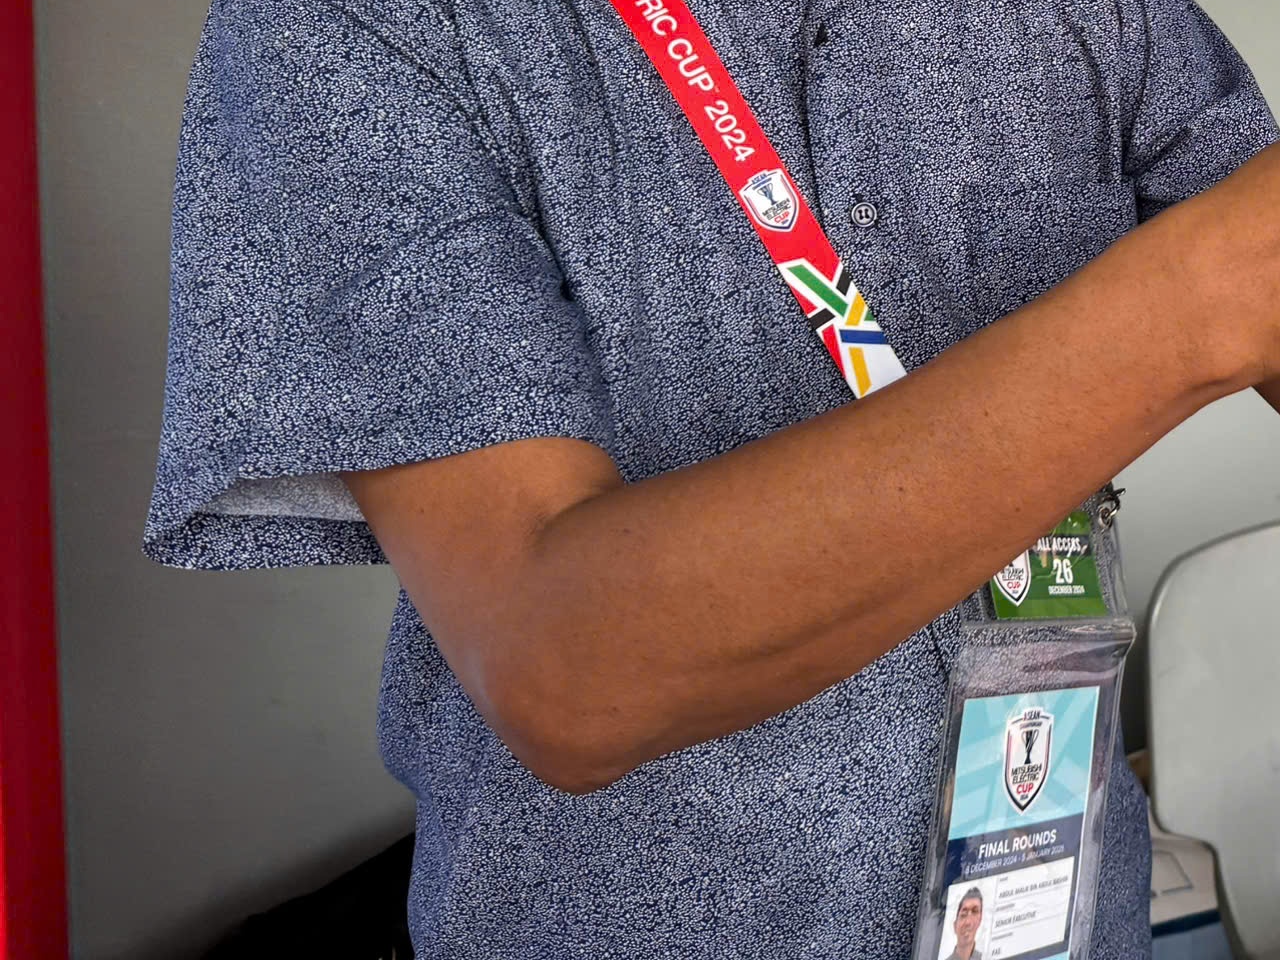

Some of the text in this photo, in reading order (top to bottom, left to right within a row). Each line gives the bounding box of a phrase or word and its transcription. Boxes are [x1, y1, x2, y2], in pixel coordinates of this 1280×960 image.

[667, 38, 714, 91] CUP
[704, 100, 755, 162] 2024
[774, 211, 790, 223] CUP
[1037, 537, 1051, 551] ALL
[1053, 558, 1074, 584] 26
[1016, 782, 1035, 794] CUP
[978, 829, 1057, 859] FINAL ROUNDS
